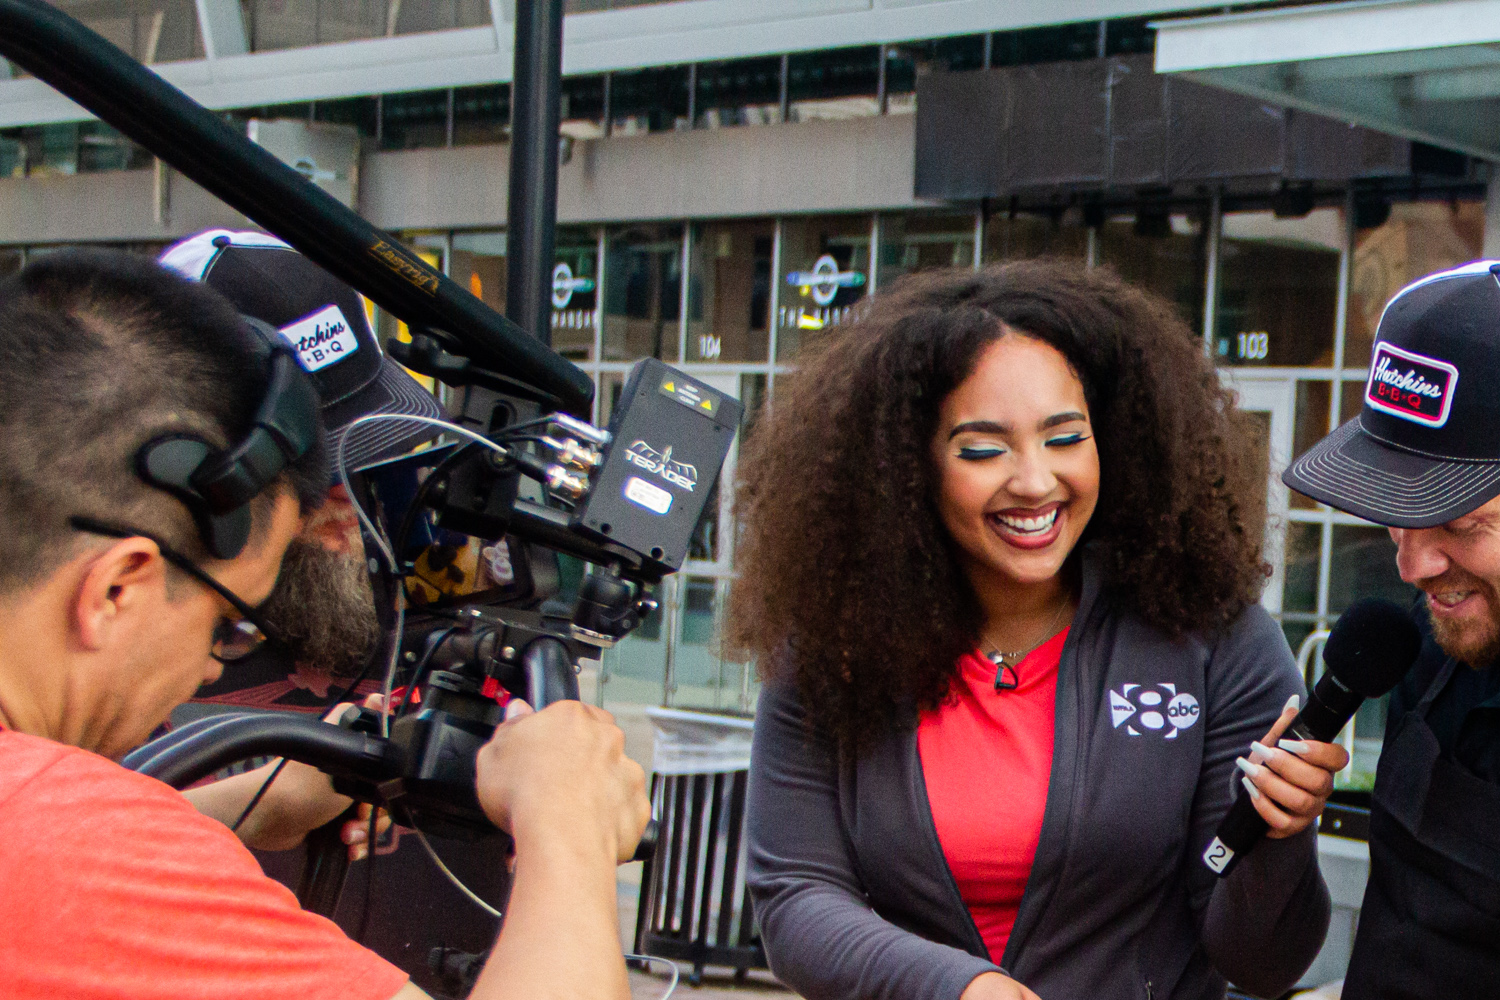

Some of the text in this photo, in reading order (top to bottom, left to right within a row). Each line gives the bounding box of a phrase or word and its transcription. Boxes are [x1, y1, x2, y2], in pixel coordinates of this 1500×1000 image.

[1238, 332, 1269, 359] 103
[1374, 356, 1442, 398] Hutchins
[624, 448, 697, 492] TERADEK
[1168, 701, 1199, 717] abc
[1208, 844, 1227, 868] 2
